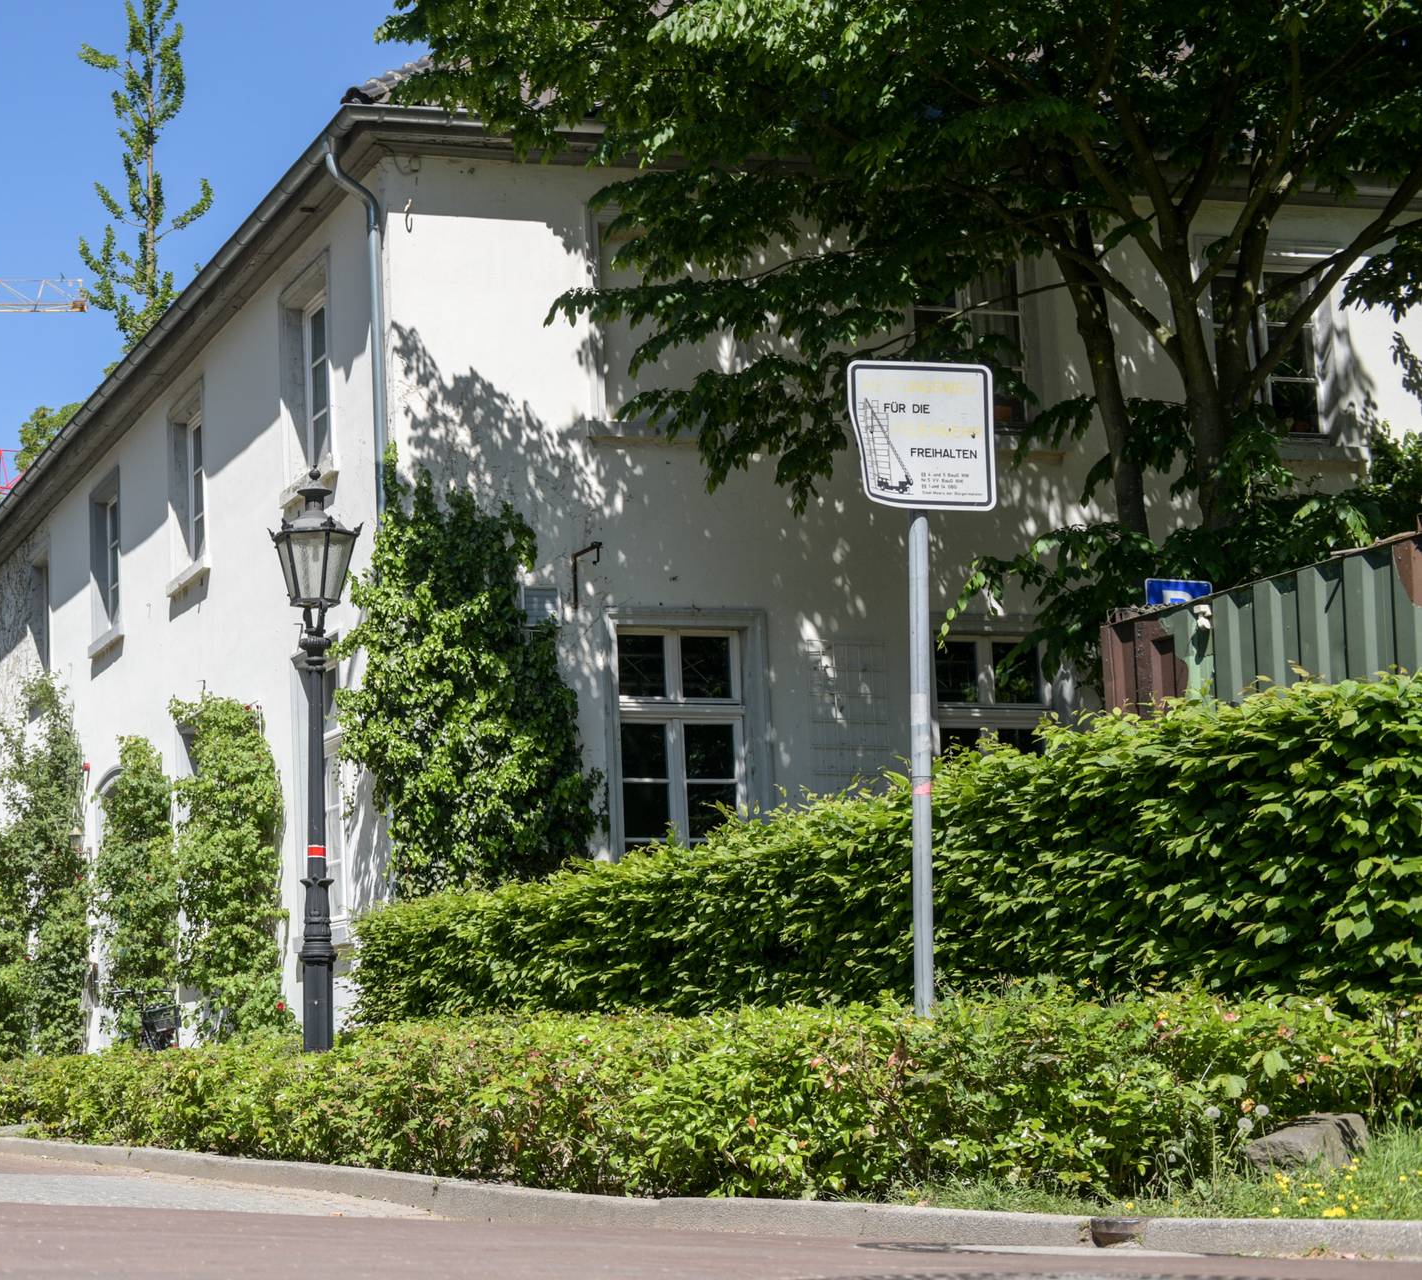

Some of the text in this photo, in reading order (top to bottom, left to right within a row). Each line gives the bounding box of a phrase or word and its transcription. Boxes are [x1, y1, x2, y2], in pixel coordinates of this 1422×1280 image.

[883, 402, 931, 414] FÜR DIE
[910, 447, 978, 460] FREIHALTEN
